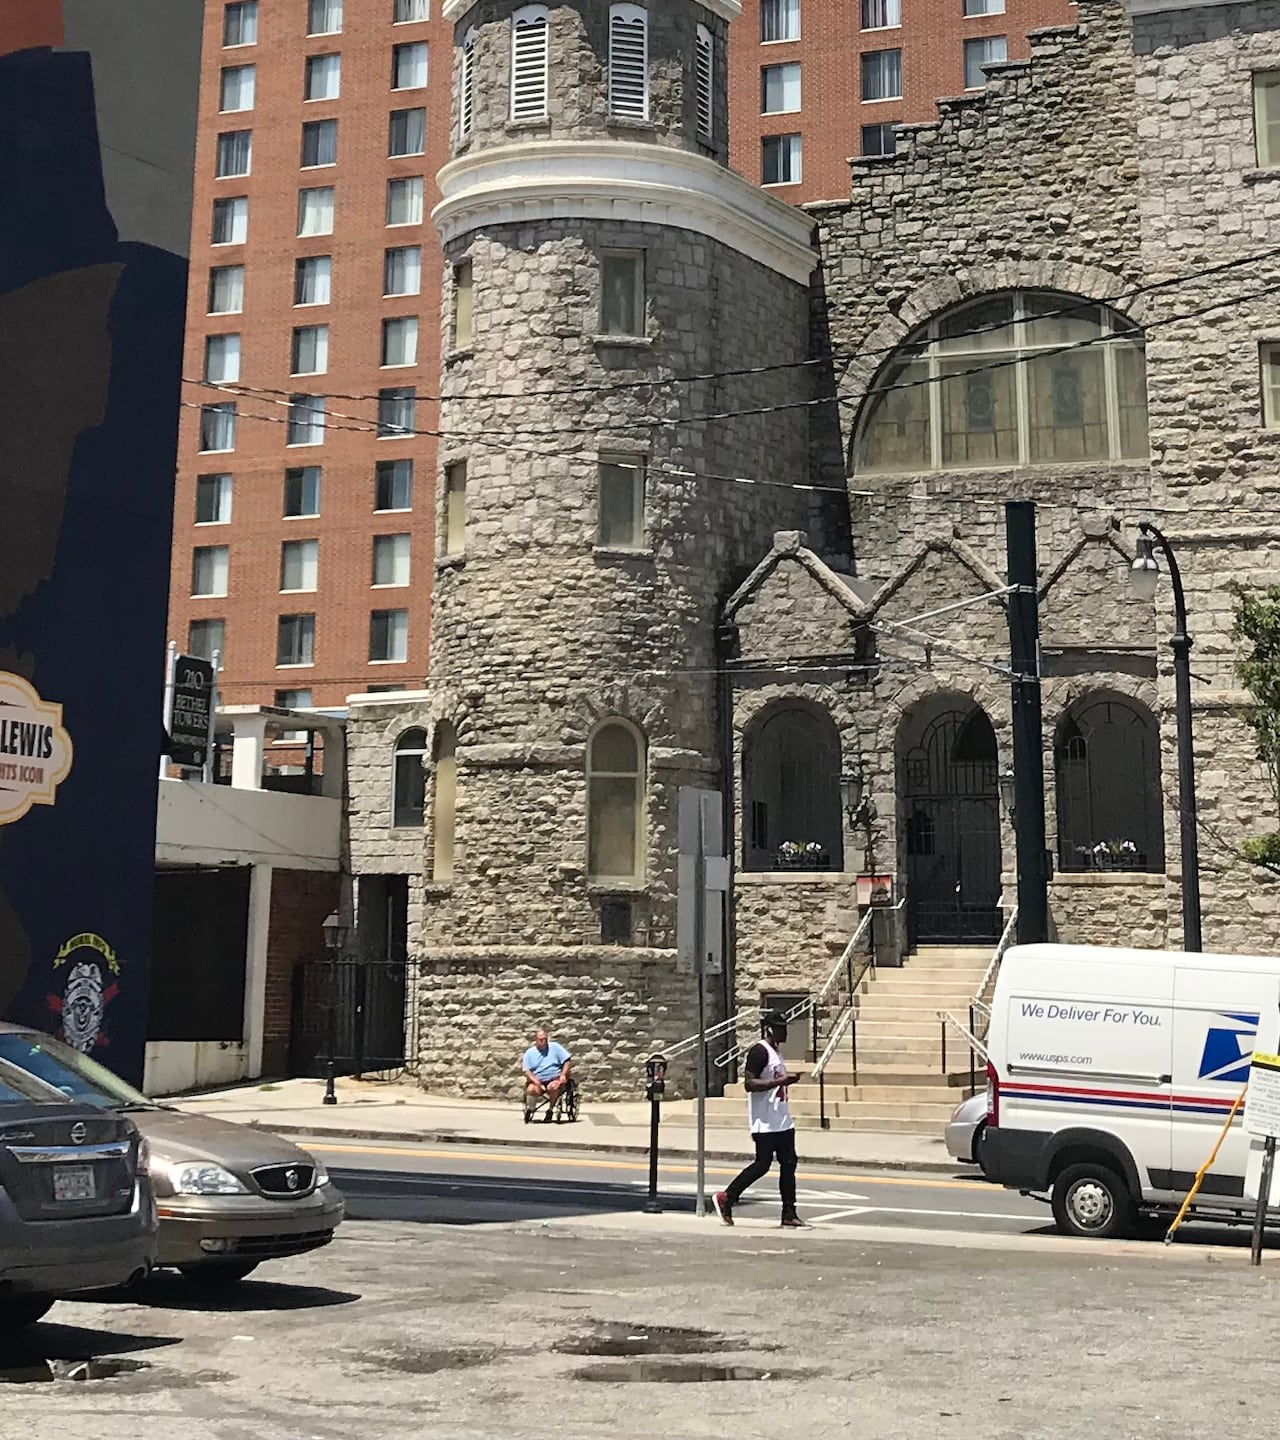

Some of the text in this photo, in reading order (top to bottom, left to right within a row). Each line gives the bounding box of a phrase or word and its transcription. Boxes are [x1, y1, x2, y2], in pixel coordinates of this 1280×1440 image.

[184, 669, 204, 690] 210
[0, 719, 53, 759] LEWIS
[19, 765, 44, 784] ICON
[1022, 1003, 1162, 1026] We Deliver For You.
[1019, 1052, 1093, 1064] www.usps.com
